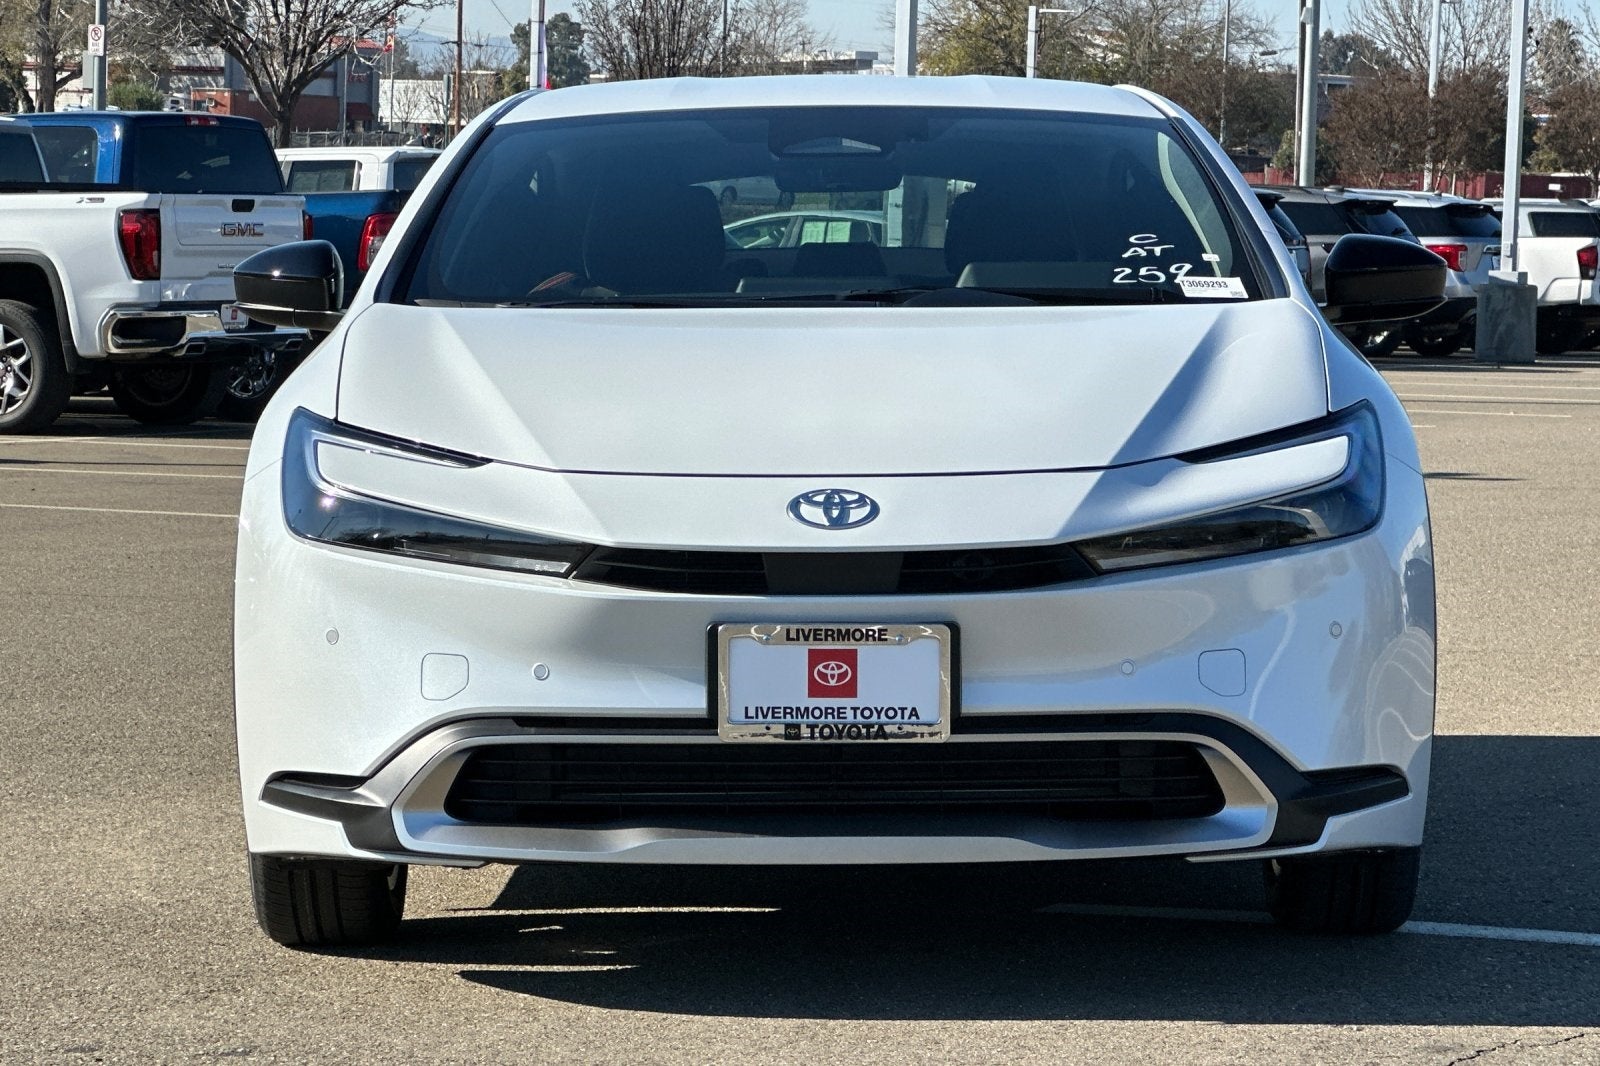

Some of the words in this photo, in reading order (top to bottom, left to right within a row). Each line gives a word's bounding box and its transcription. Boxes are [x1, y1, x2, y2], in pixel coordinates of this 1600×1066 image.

[220, 222, 264, 236] GMC
[1129, 233, 1159, 244] C
[1122, 245, 1174, 258] AT
[1113, 263, 1192, 284] 259
[1181, 279, 1228, 289] T3069293
[785, 628, 888, 642] LIVERMORE
[744, 706, 847, 720] LIVERMORE
[850, 706, 920, 720] TOYOTA
[807, 724, 887, 740] TOYOTA
